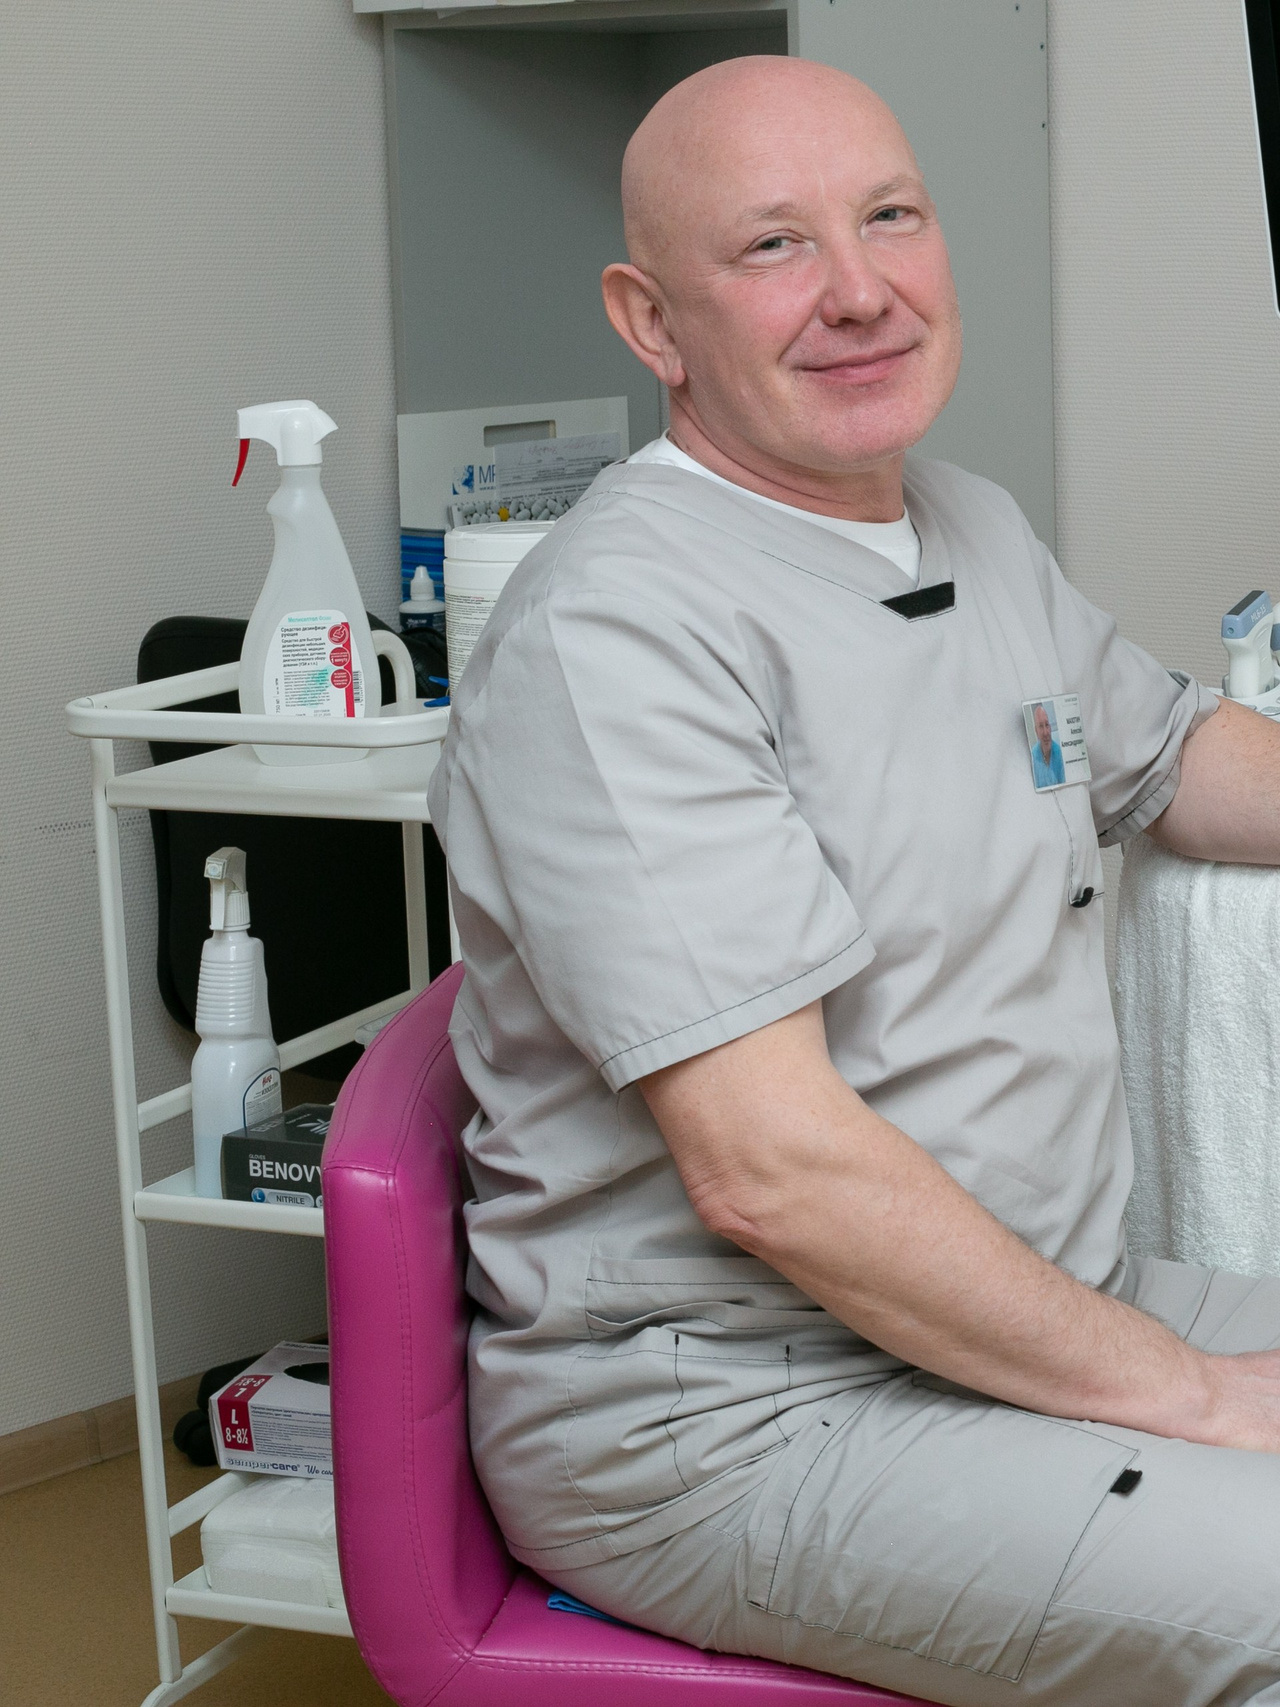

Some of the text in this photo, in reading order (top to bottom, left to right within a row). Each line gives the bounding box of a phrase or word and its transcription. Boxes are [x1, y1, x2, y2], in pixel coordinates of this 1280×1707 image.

[276, 1195, 305, 1205] NITRILE
[231, 1408, 239, 1425] L
[225, 1427, 249, 1445] 8-8½
[304, 1464, 320, 1475] We
